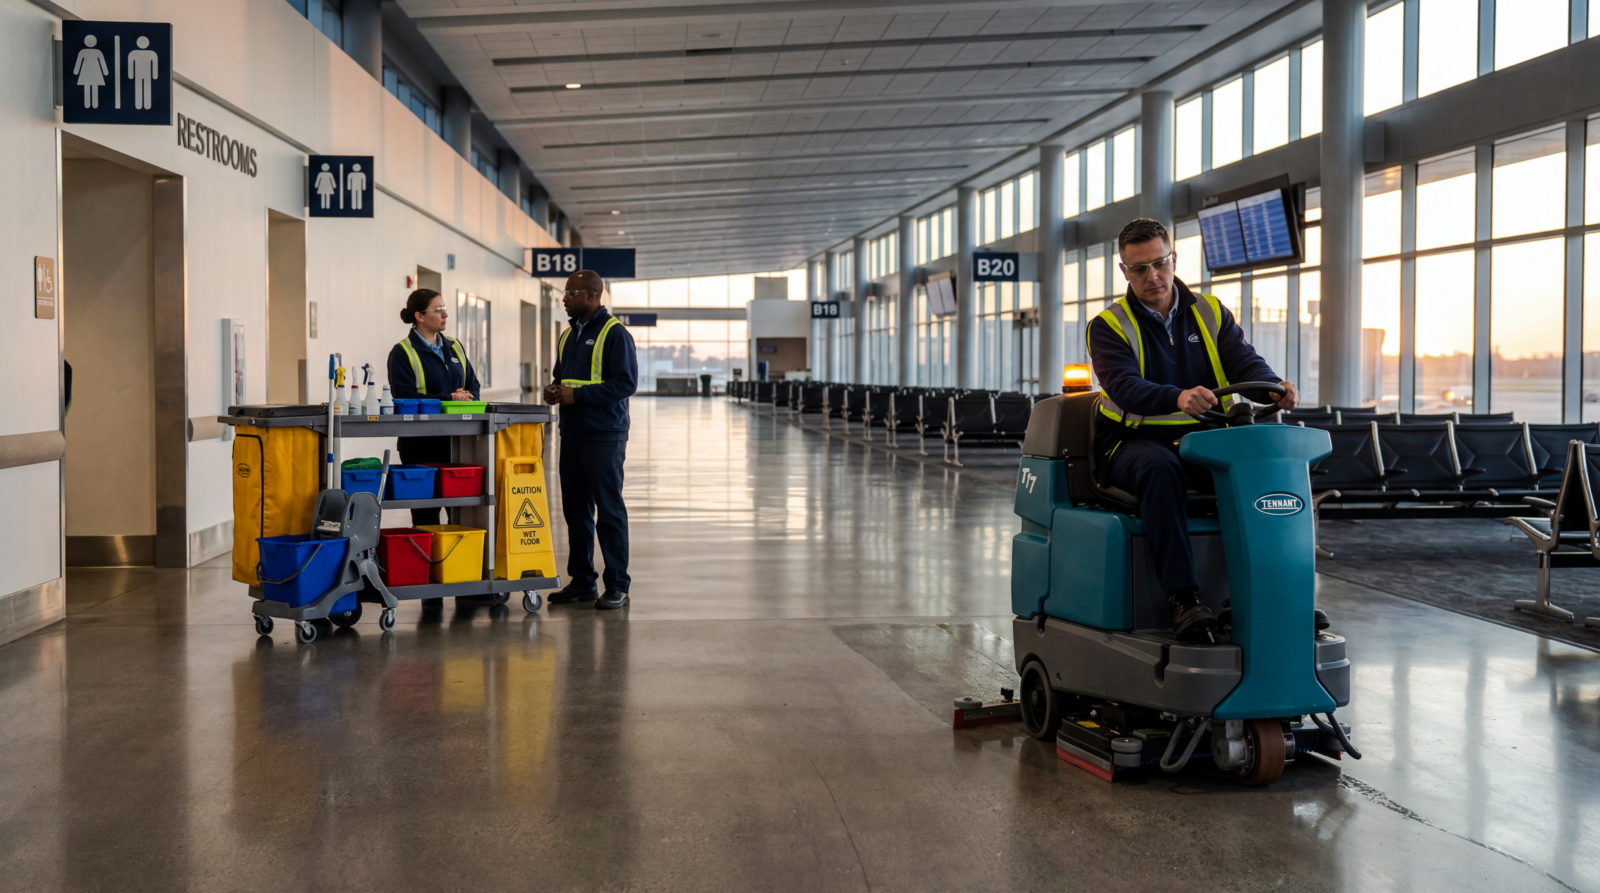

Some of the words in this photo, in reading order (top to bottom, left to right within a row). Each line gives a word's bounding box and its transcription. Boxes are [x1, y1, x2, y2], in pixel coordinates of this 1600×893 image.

[177, 112, 257, 178] RESTROOMS
[537, 253, 577, 272] B18
[977, 258, 1015, 276] B20
[813, 303, 838, 316] B18
[1021, 467, 1037, 494] T17
[511, 486, 542, 495] CAUTION
[1260, 499, 1298, 509] TENNANT
[522, 530, 536, 538] WET
[520, 538, 541, 546] FLOOR
